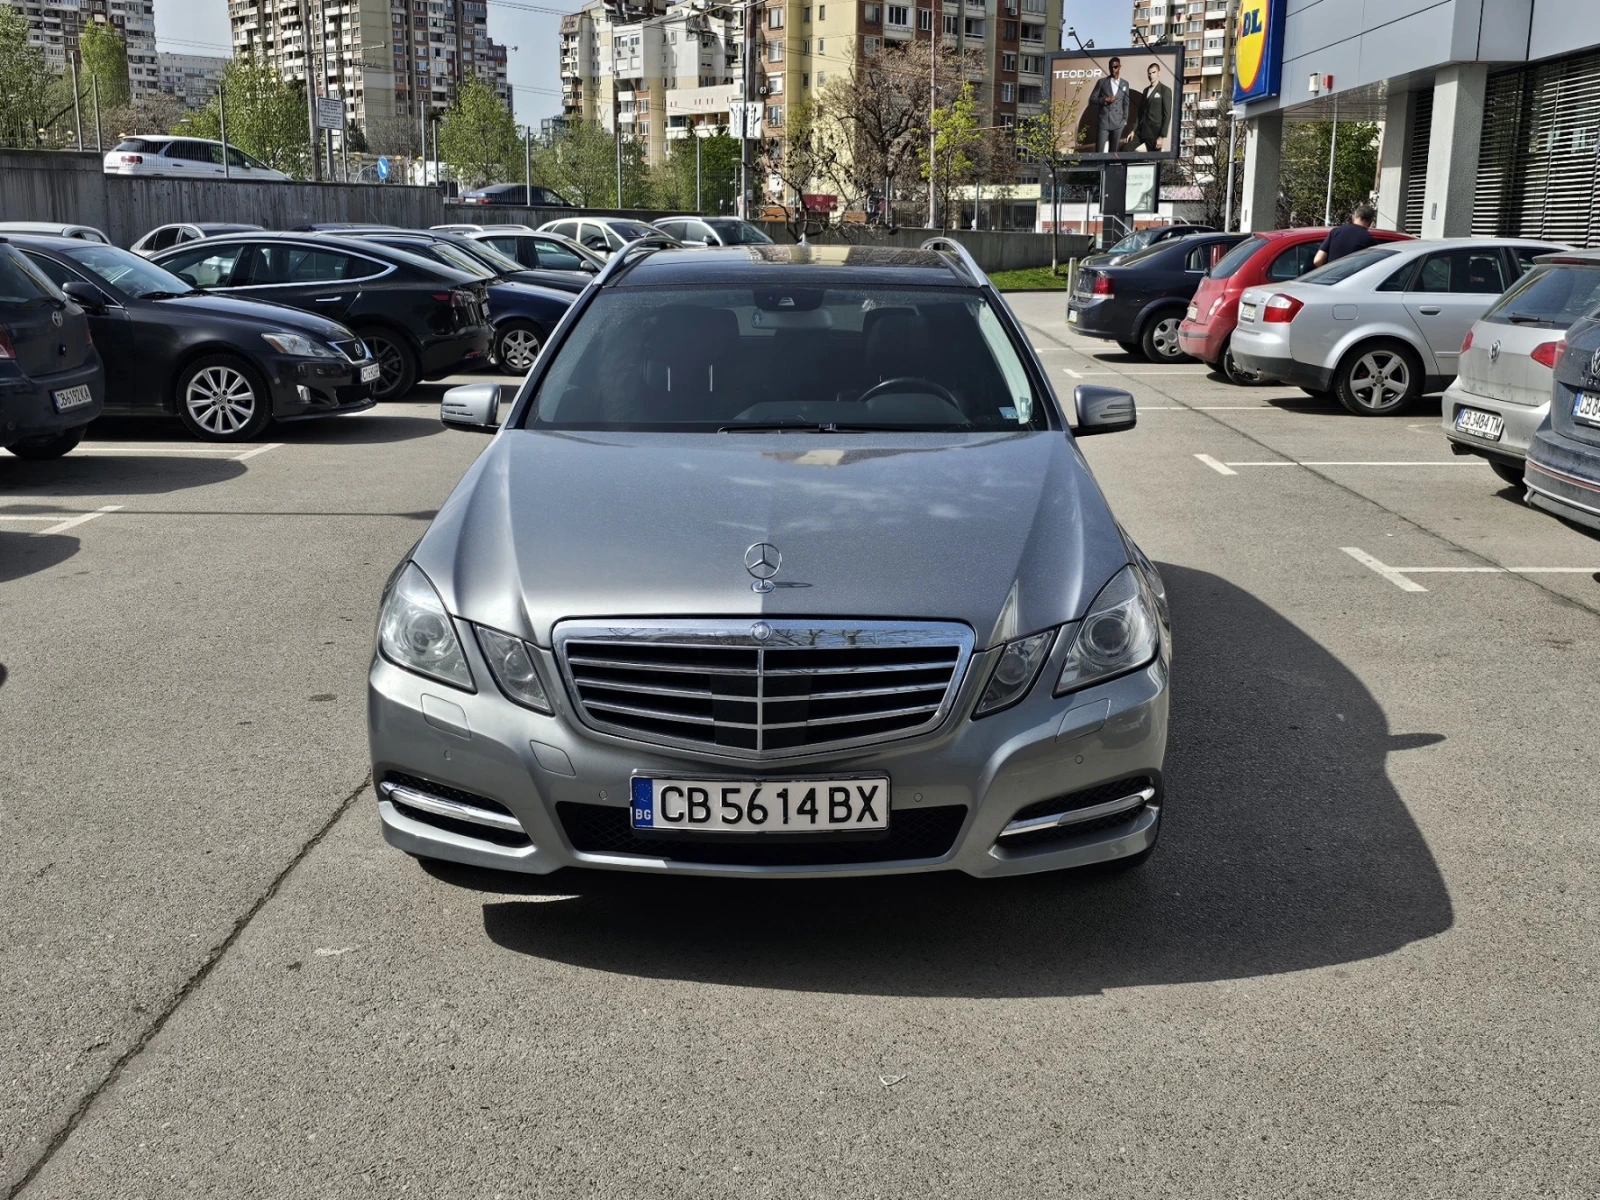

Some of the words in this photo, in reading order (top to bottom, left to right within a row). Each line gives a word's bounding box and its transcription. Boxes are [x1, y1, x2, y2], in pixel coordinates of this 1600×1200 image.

[1053, 69, 1103, 79] TEODOR
[635, 809, 652, 821] BG
[660, 786, 879, 825] CB5614BX
